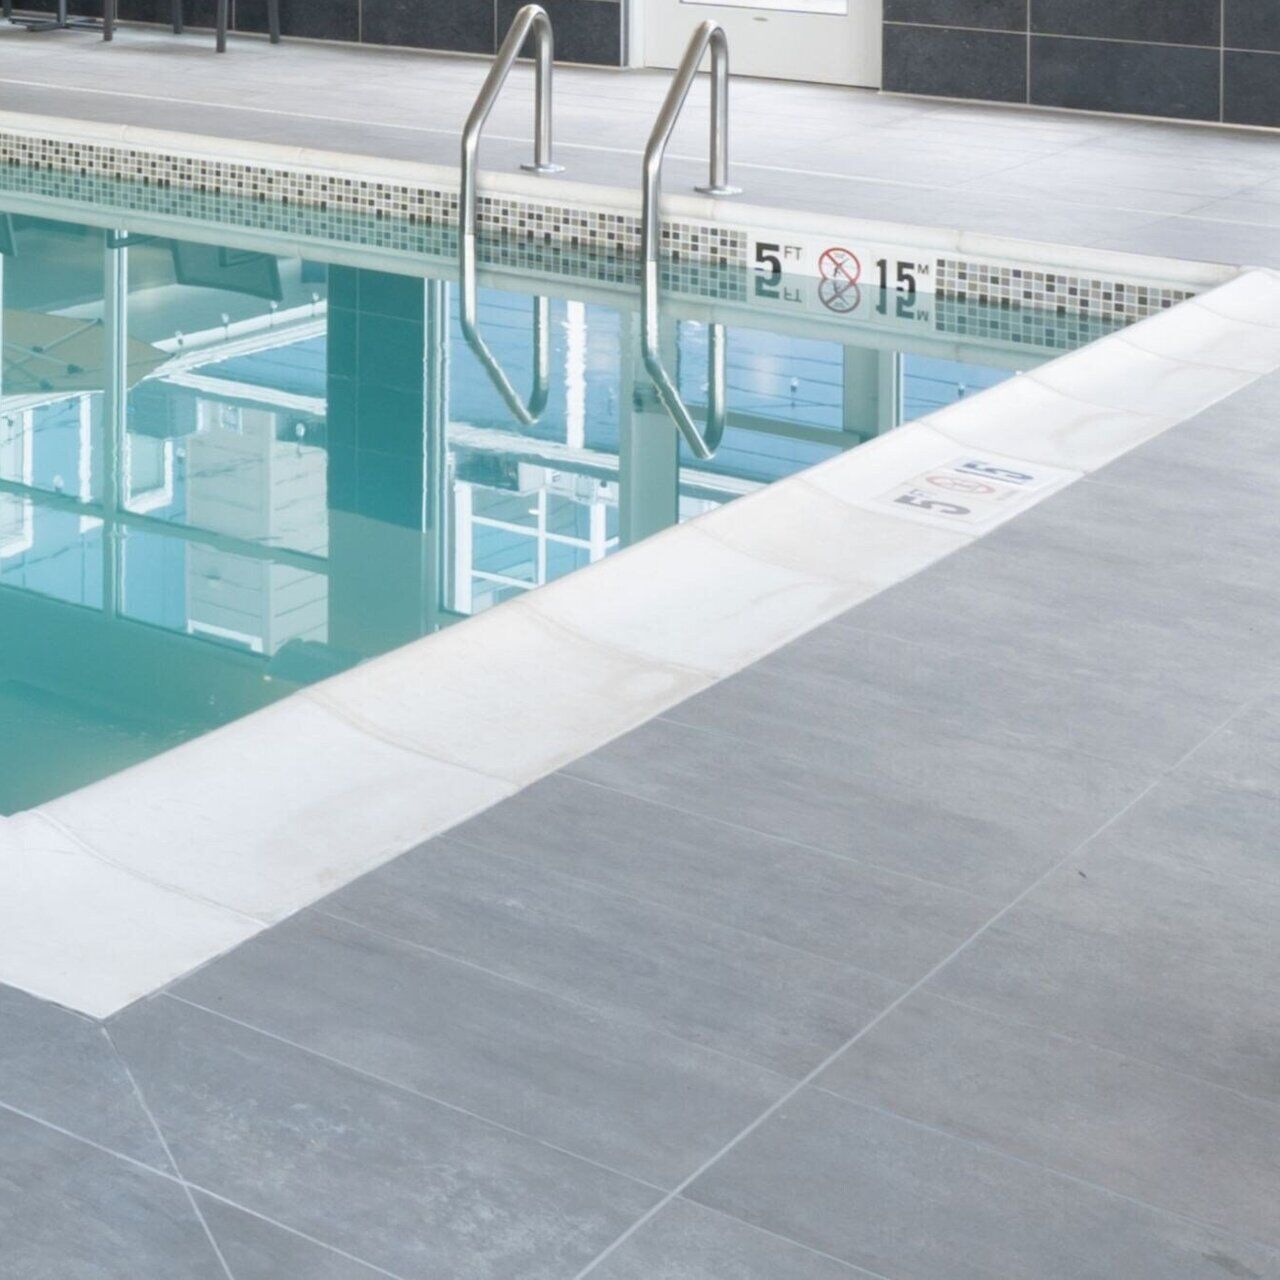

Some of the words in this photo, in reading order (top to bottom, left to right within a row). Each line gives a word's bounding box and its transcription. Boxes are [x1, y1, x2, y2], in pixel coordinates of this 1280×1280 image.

[755, 242, 781, 273] 5
[784, 246, 803, 261] FT
[918, 263, 929, 275] M
